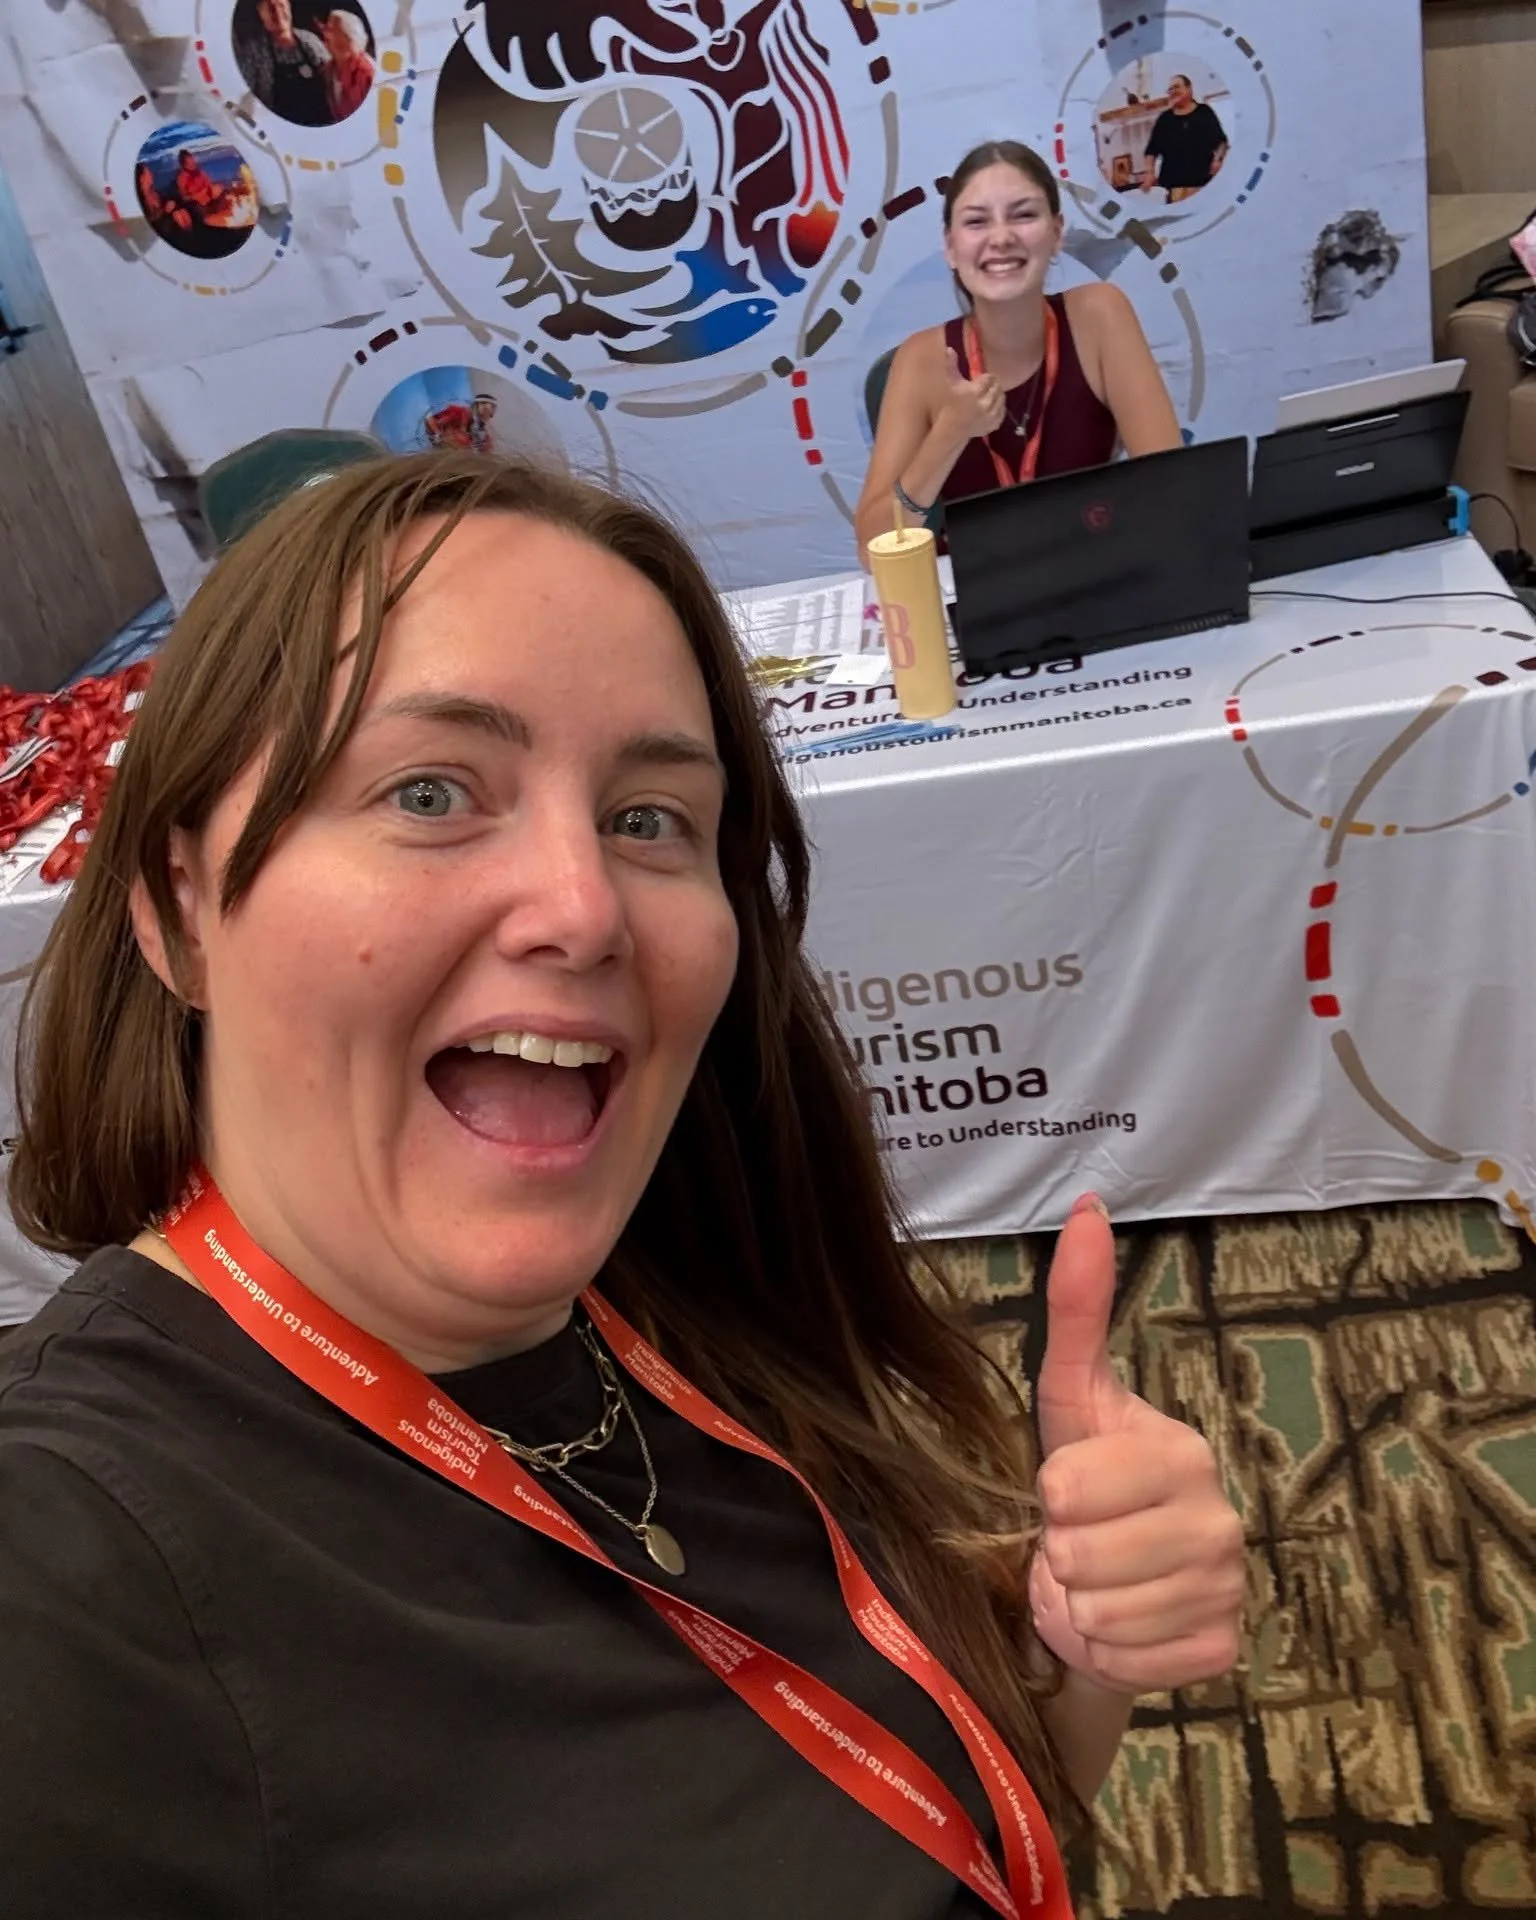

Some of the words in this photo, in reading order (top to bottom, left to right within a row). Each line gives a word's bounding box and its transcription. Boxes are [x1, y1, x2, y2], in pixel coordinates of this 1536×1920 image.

[775, 711, 908, 739] dventure
[957, 665, 1193, 710] Understanding
[781, 696, 1193, 765] igenoustourismmanitoba.ca
[821, 952, 1083, 1022] digenous
[853, 1022, 1001, 1067] rism
[863, 1065, 1049, 1117] nitoba
[916, 1131, 943, 1150] to
[949, 1110, 1137, 1144] Understanding
[203, 1228, 285, 1320] Understanding
[283, 1312, 301, 1333] to
[300, 1324, 380, 1386] Adventure
[397, 1419, 477, 1481] Indigenous
[426, 1418, 481, 1466] Tourism
[427, 1398, 489, 1454] Manitoba
[774, 1680, 867, 1764] Understanding
[866, 1755, 884, 1776] to
